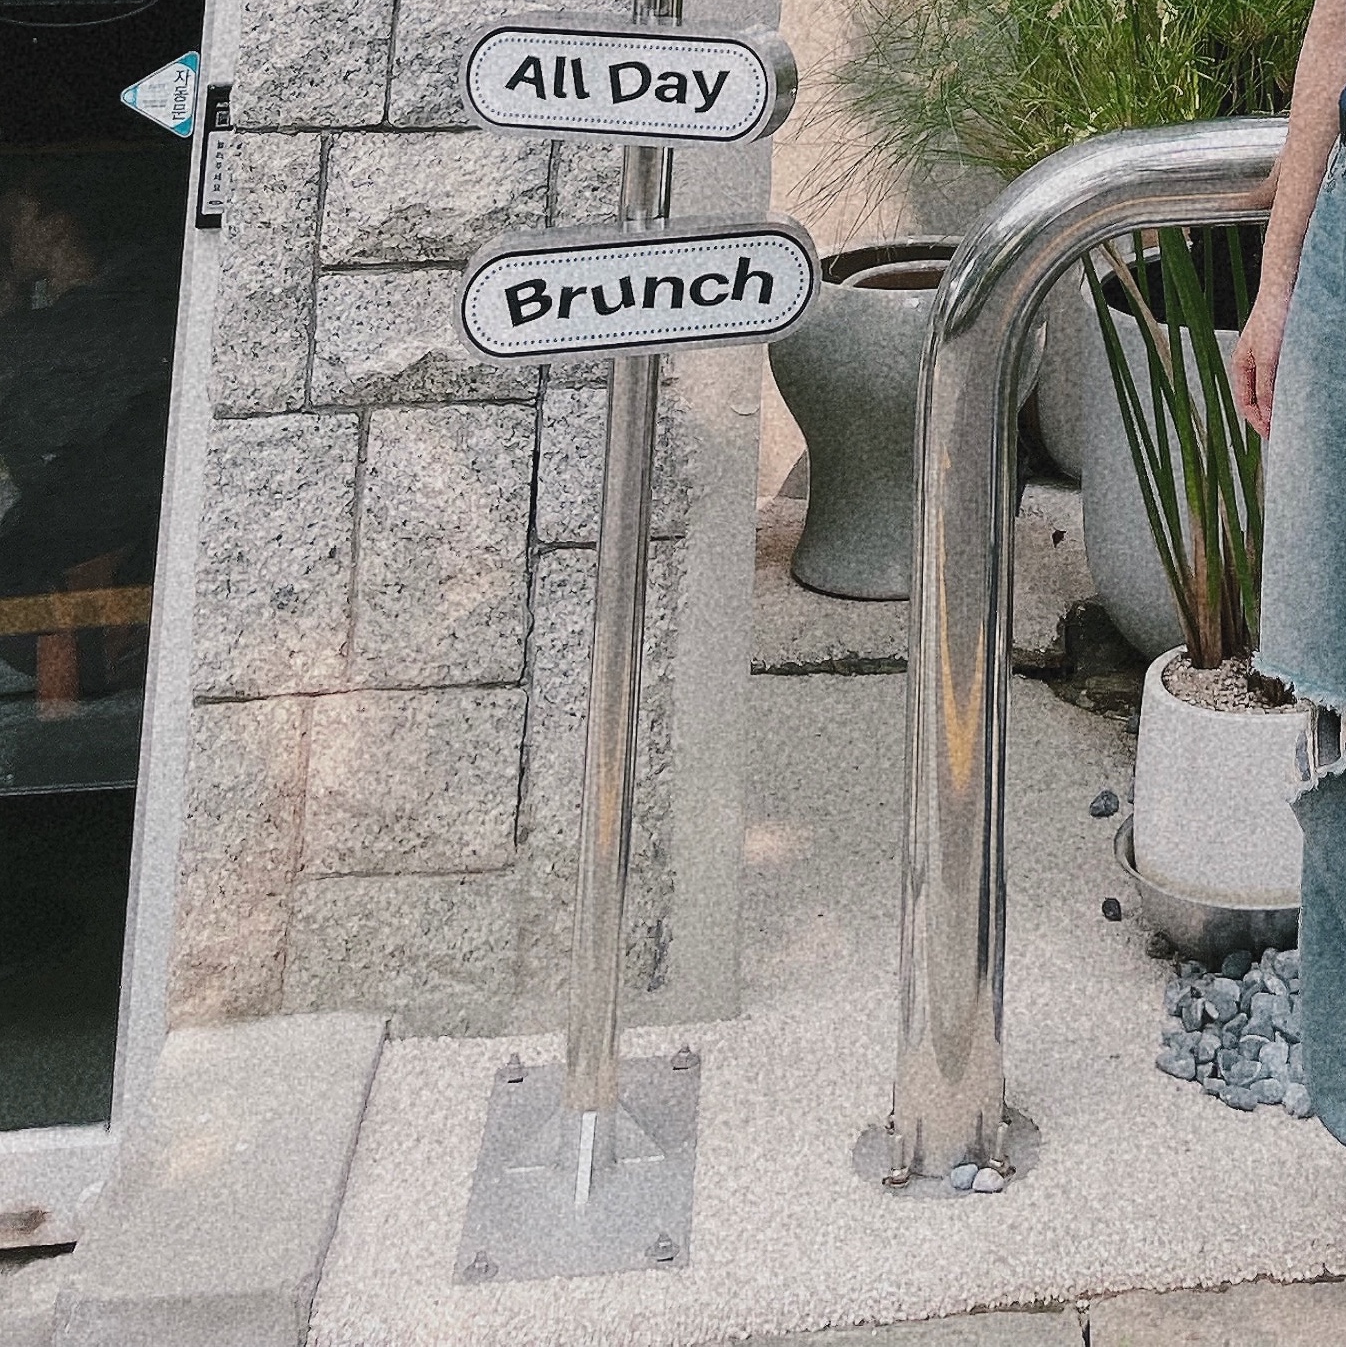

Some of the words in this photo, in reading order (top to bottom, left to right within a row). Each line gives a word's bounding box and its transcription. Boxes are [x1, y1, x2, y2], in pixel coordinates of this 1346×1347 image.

[172, 68, 191, 122] 자동문
[505, 55, 590, 100] All
[608, 60, 731, 114] Day
[504, 256, 775, 327] Brunch
